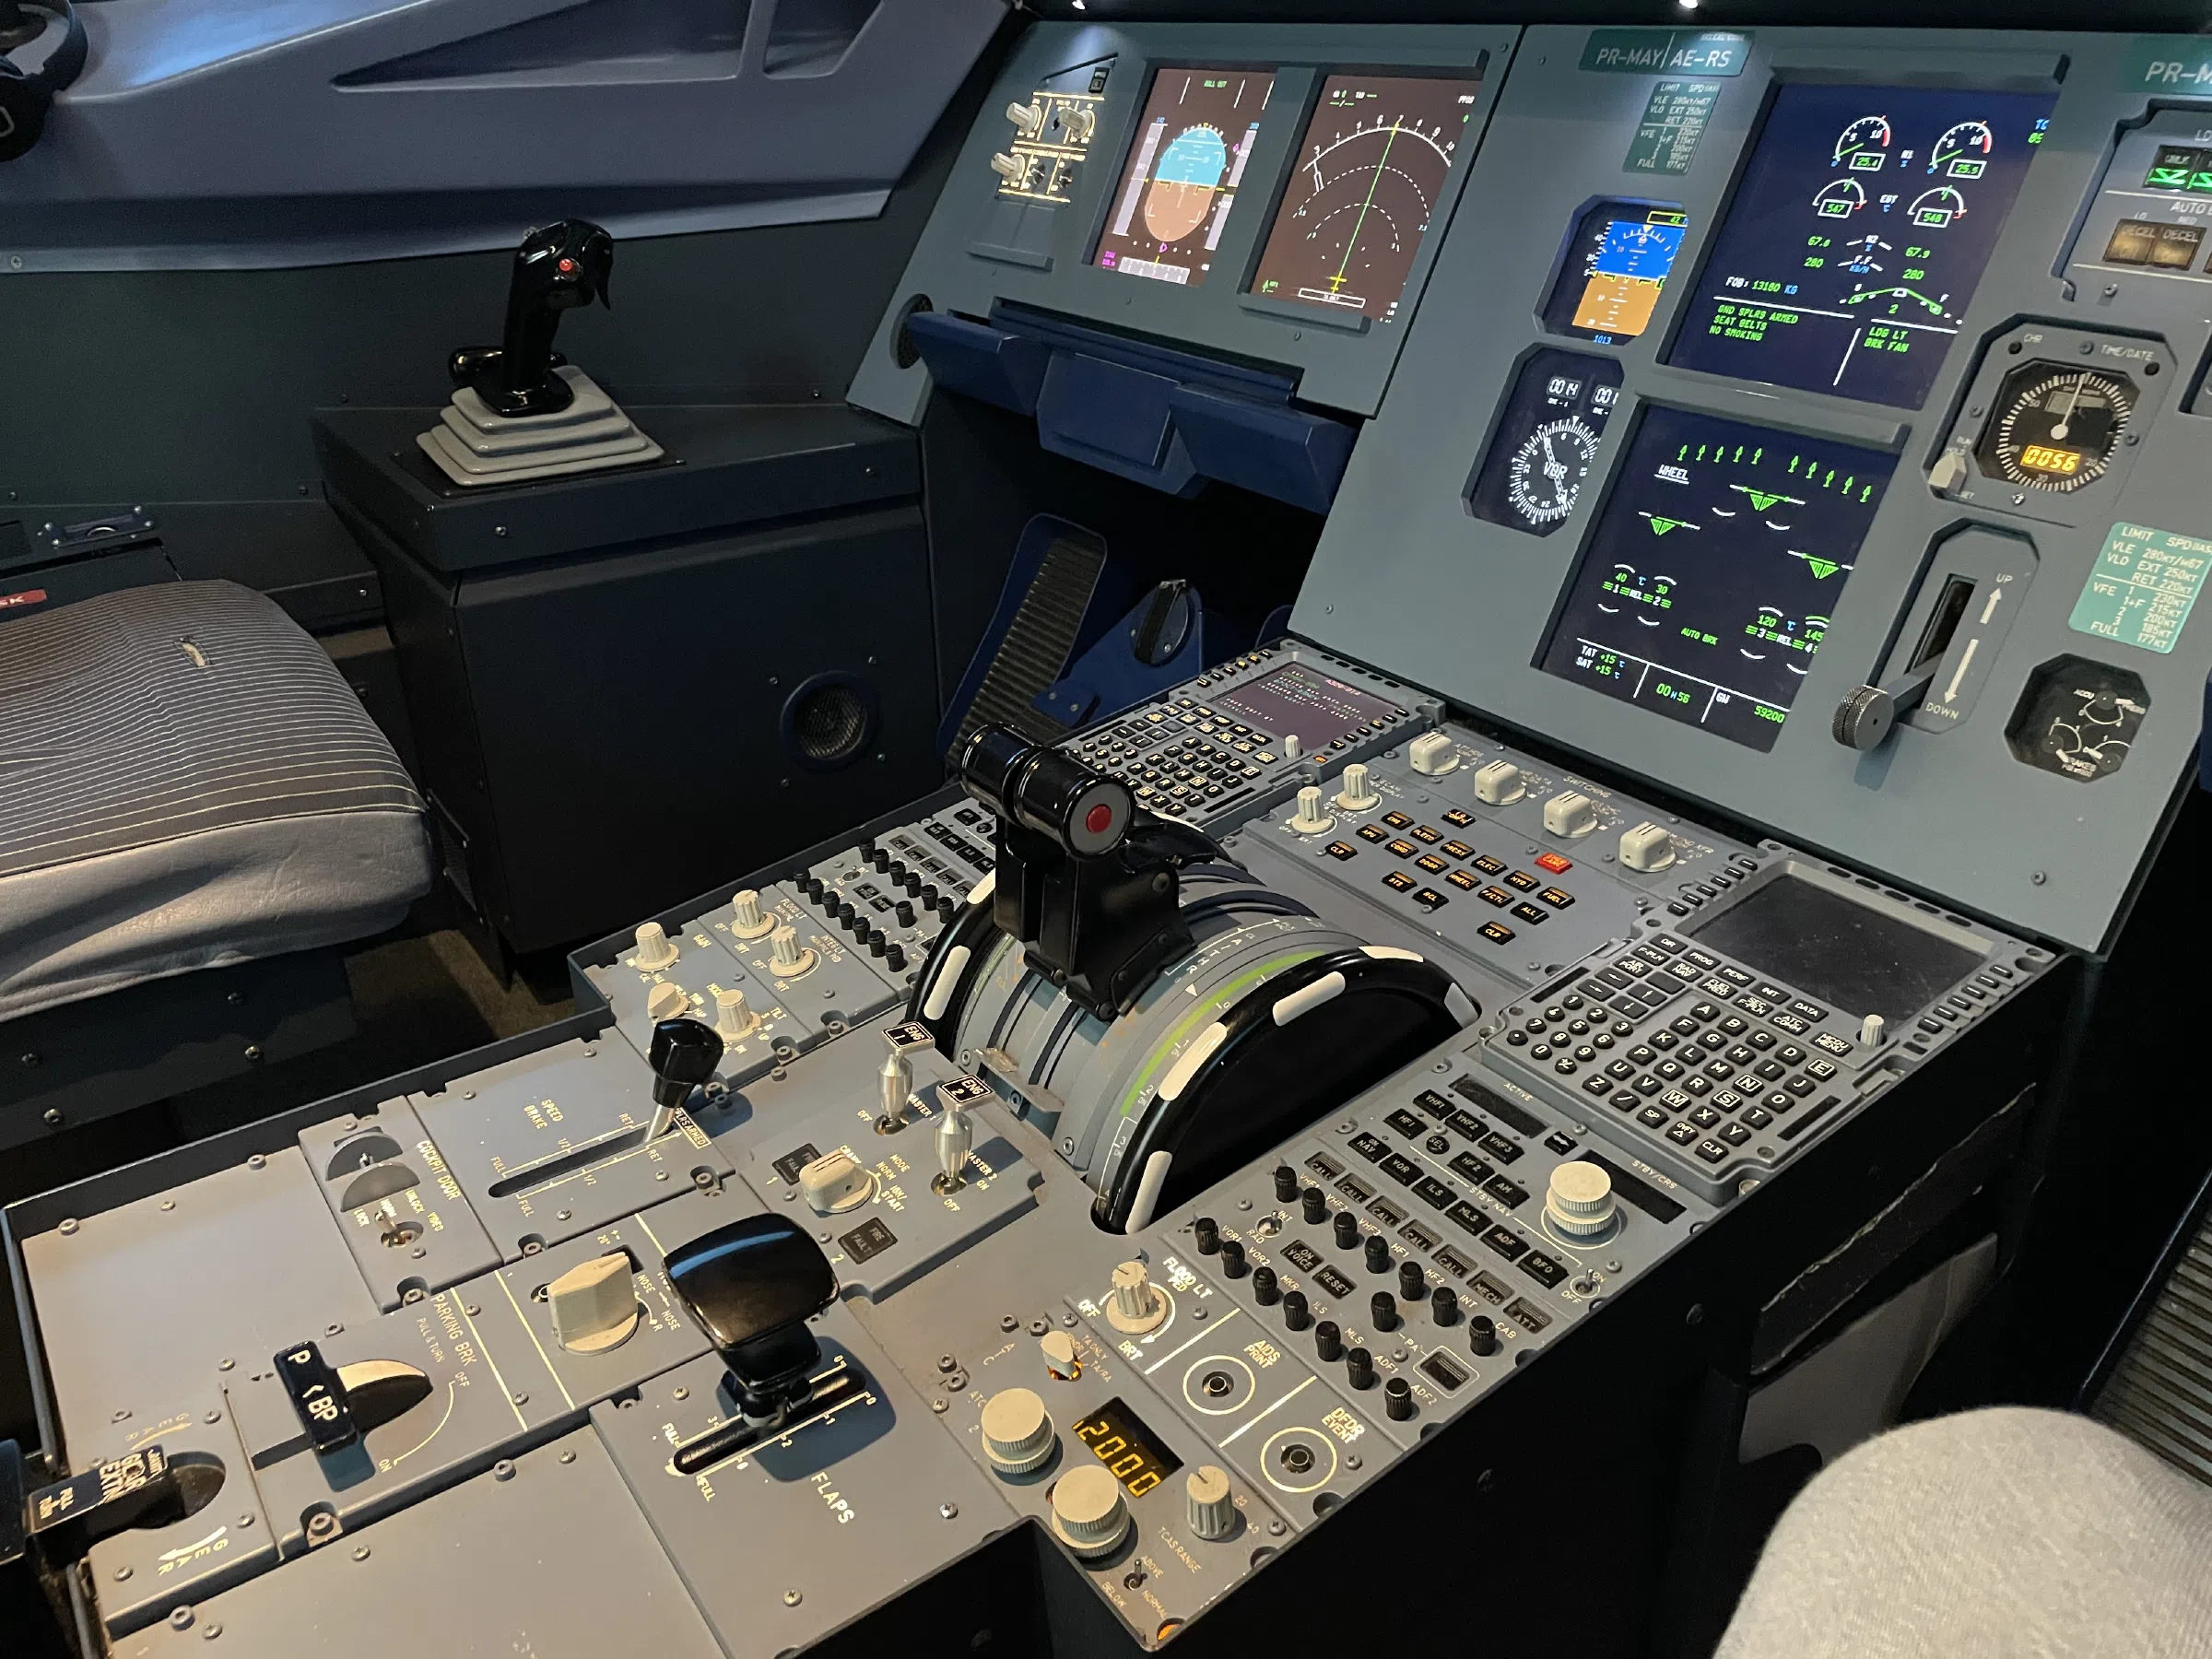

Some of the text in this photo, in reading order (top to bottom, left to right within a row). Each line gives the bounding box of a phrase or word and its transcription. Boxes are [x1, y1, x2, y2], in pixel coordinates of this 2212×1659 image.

[1595, 48, 1733, 67] PR-MAY AE-RS
[2171, 202, 2206, 215] AUTO
[2163, 230, 2198, 242] DECEL
[1805, 258, 1824, 268] 280
[1902, 269, 1924, 279] 280
[1717, 305, 1798, 324] GND SPLRS ARMED
[1713, 316, 1767, 331] SEAT BELTS
[1594, 335, 1612, 344] 1013
[1710, 326, 1763, 341] NO SMOKING
[1892, 330, 1908, 340] LT
[1864, 338, 1910, 352] BRK FAN
[2100, 345, 2155, 361] TIME/DATE
[2023, 449, 2079, 472] 0056
[1659, 465, 1688, 480] WHEEL
[2122, 526, 2192, 550] LIMIT SPD
[2112, 541, 2136, 554] VLE
[2107, 553, 2198, 582] VLO EXT 250KT
[1615, 573, 1627, 582] 40
[1996, 572, 2013, 583] UP
[2132, 572, 2194, 594] RET 220KT
[1655, 584, 1668, 594] 30
[2093, 582, 2187, 607] VFE 1 230KT
[2118, 606, 2178, 628] 2 200KT
[2148, 603, 2183, 618] 215KT
[1758, 615, 1777, 628] 120
[2113, 617, 2173, 638] 3 185KT
[1681, 628, 1718, 645] AUTO BRK
[1804, 629, 1825, 642] 145
[2090, 621, 2168, 648] FULL 177KT
[1581, 646, 1597, 657] TAT
[1576, 657, 1594, 669] SAT
[1754, 705, 1785, 724] 59200
[1925, 702, 1959, 720] DOWN
[1563, 776, 1611, 798] SWITCHING
[1543, 892, 1561, 903] FUEL
[1521, 906, 1537, 916] ALL
[1661, 938, 1676, 948] DIR
[1638, 947, 1665, 961] F-PLN
[1689, 952, 1713, 966] PROG
[1723, 968, 1748, 982] PERF
[1794, 1003, 1818, 1017] DATA
[1773, 1017, 1802, 1032] COMM
[904, 1026, 925, 1041] ENG
[1816, 1038, 1843, 1053] MENU
[961, 1080, 984, 1095] ENG
[1503, 1082, 1533, 1101] ACTIVE
[1426, 1094, 1445, 1110] VHF1
[524, 1105, 549, 1130] BRAKE
[541, 1099, 564, 1123] SPEED
[857, 1110, 873, 1123] OFF
[1644, 1109, 1660, 1119] SP
[1398, 1114, 1415, 1128] HF1
[1457, 1113, 1479, 1130] VHF2
[1430, 1136, 1444, 1150] SEL
[1489, 1135, 1513, 1152] VHF3
[1702, 1141, 1723, 1155] CLR
[647, 1148, 663, 1162] RET
[890, 1154, 911, 1172] MODE
[417, 1140, 461, 1201] COCKPIT DOOR
[876, 1161, 896, 1181] NORM
[1311, 1163, 1333, 1180] CALL
[1392, 1159, 1410, 1173] VOR
[1630, 1159, 1678, 1190] STBY/CRS
[976, 1180, 990, 1191] ON
[1341, 1184, 1363, 1204] CALL
[1427, 1184, 1443, 1196] ILS
[1495, 1182, 1512, 1193] AM
[518, 1199, 535, 1218] FULL
[881, 1191, 905, 1213] START
[943, 1199, 960, 1213] OFF
[1325, 1194, 1348, 1213] VHF2
[1469, 1187, 1513, 1218] STBY NAV
[428, 1211, 444, 1231] VIDEO
[1371, 1208, 1395, 1226] CALL
[1458, 1206, 1479, 1222] MLS
[1358, 1218, 1382, 1236] VHF3
[1245, 1230, 1265, 1244] RAD
[1405, 1232, 1428, 1251] CALL
[1494, 1232, 1516, 1246] ADF
[1248, 1246, 1271, 1266] VOR2
[1391, 1243, 1410, 1258] HF1
[1288, 1250, 1313, 1270] VOICE
[1438, 1257, 1461, 1278] CALL
[637, 1275, 656, 1293] NOSE
[1162, 1256, 1213, 1300] FLOOD LT
[1279, 1275, 1300, 1290] MKR
[1321, 1272, 1349, 1295] RESET
[1425, 1269, 1445, 1285] HF2
[1473, 1282, 1500, 1306] MECH
[1560, 1289, 1583, 1304] OFF
[1077, 1300, 1101, 1317] OFF
[662, 1310, 680, 1331] NOSE
[1513, 1311, 1537, 1329] ATT
[430, 1294, 477, 1367] PARKING BRK
[1345, 1326, 1365, 1345] MLS
[1495, 1321, 1517, 1339] CAB
[417, 1317, 431, 1336] PULL
[429, 1341, 445, 1363] TURN
[288, 1349, 312, 1364] P
[1118, 1340, 1144, 1361] BRT
[1253, 1339, 1282, 1361] AIDS
[1373, 1354, 1400, 1375] ADF1
[454, 1371, 470, 1387] OFF
[1409, 1383, 1438, 1407] ADF2
[1321, 1416, 1358, 1444] EVENT
[1331, 1407, 1366, 1436] DFDR
[378, 1458, 392, 1473] ON
[100, 1462, 124, 1503] EXTN
[810, 1471, 855, 1524] FLAPS
[1140, 1556, 1164, 1578] ABOVE
[1101, 1582, 1128, 1607] BELOW
[1142, 1590, 1168, 1618] NORMAL
